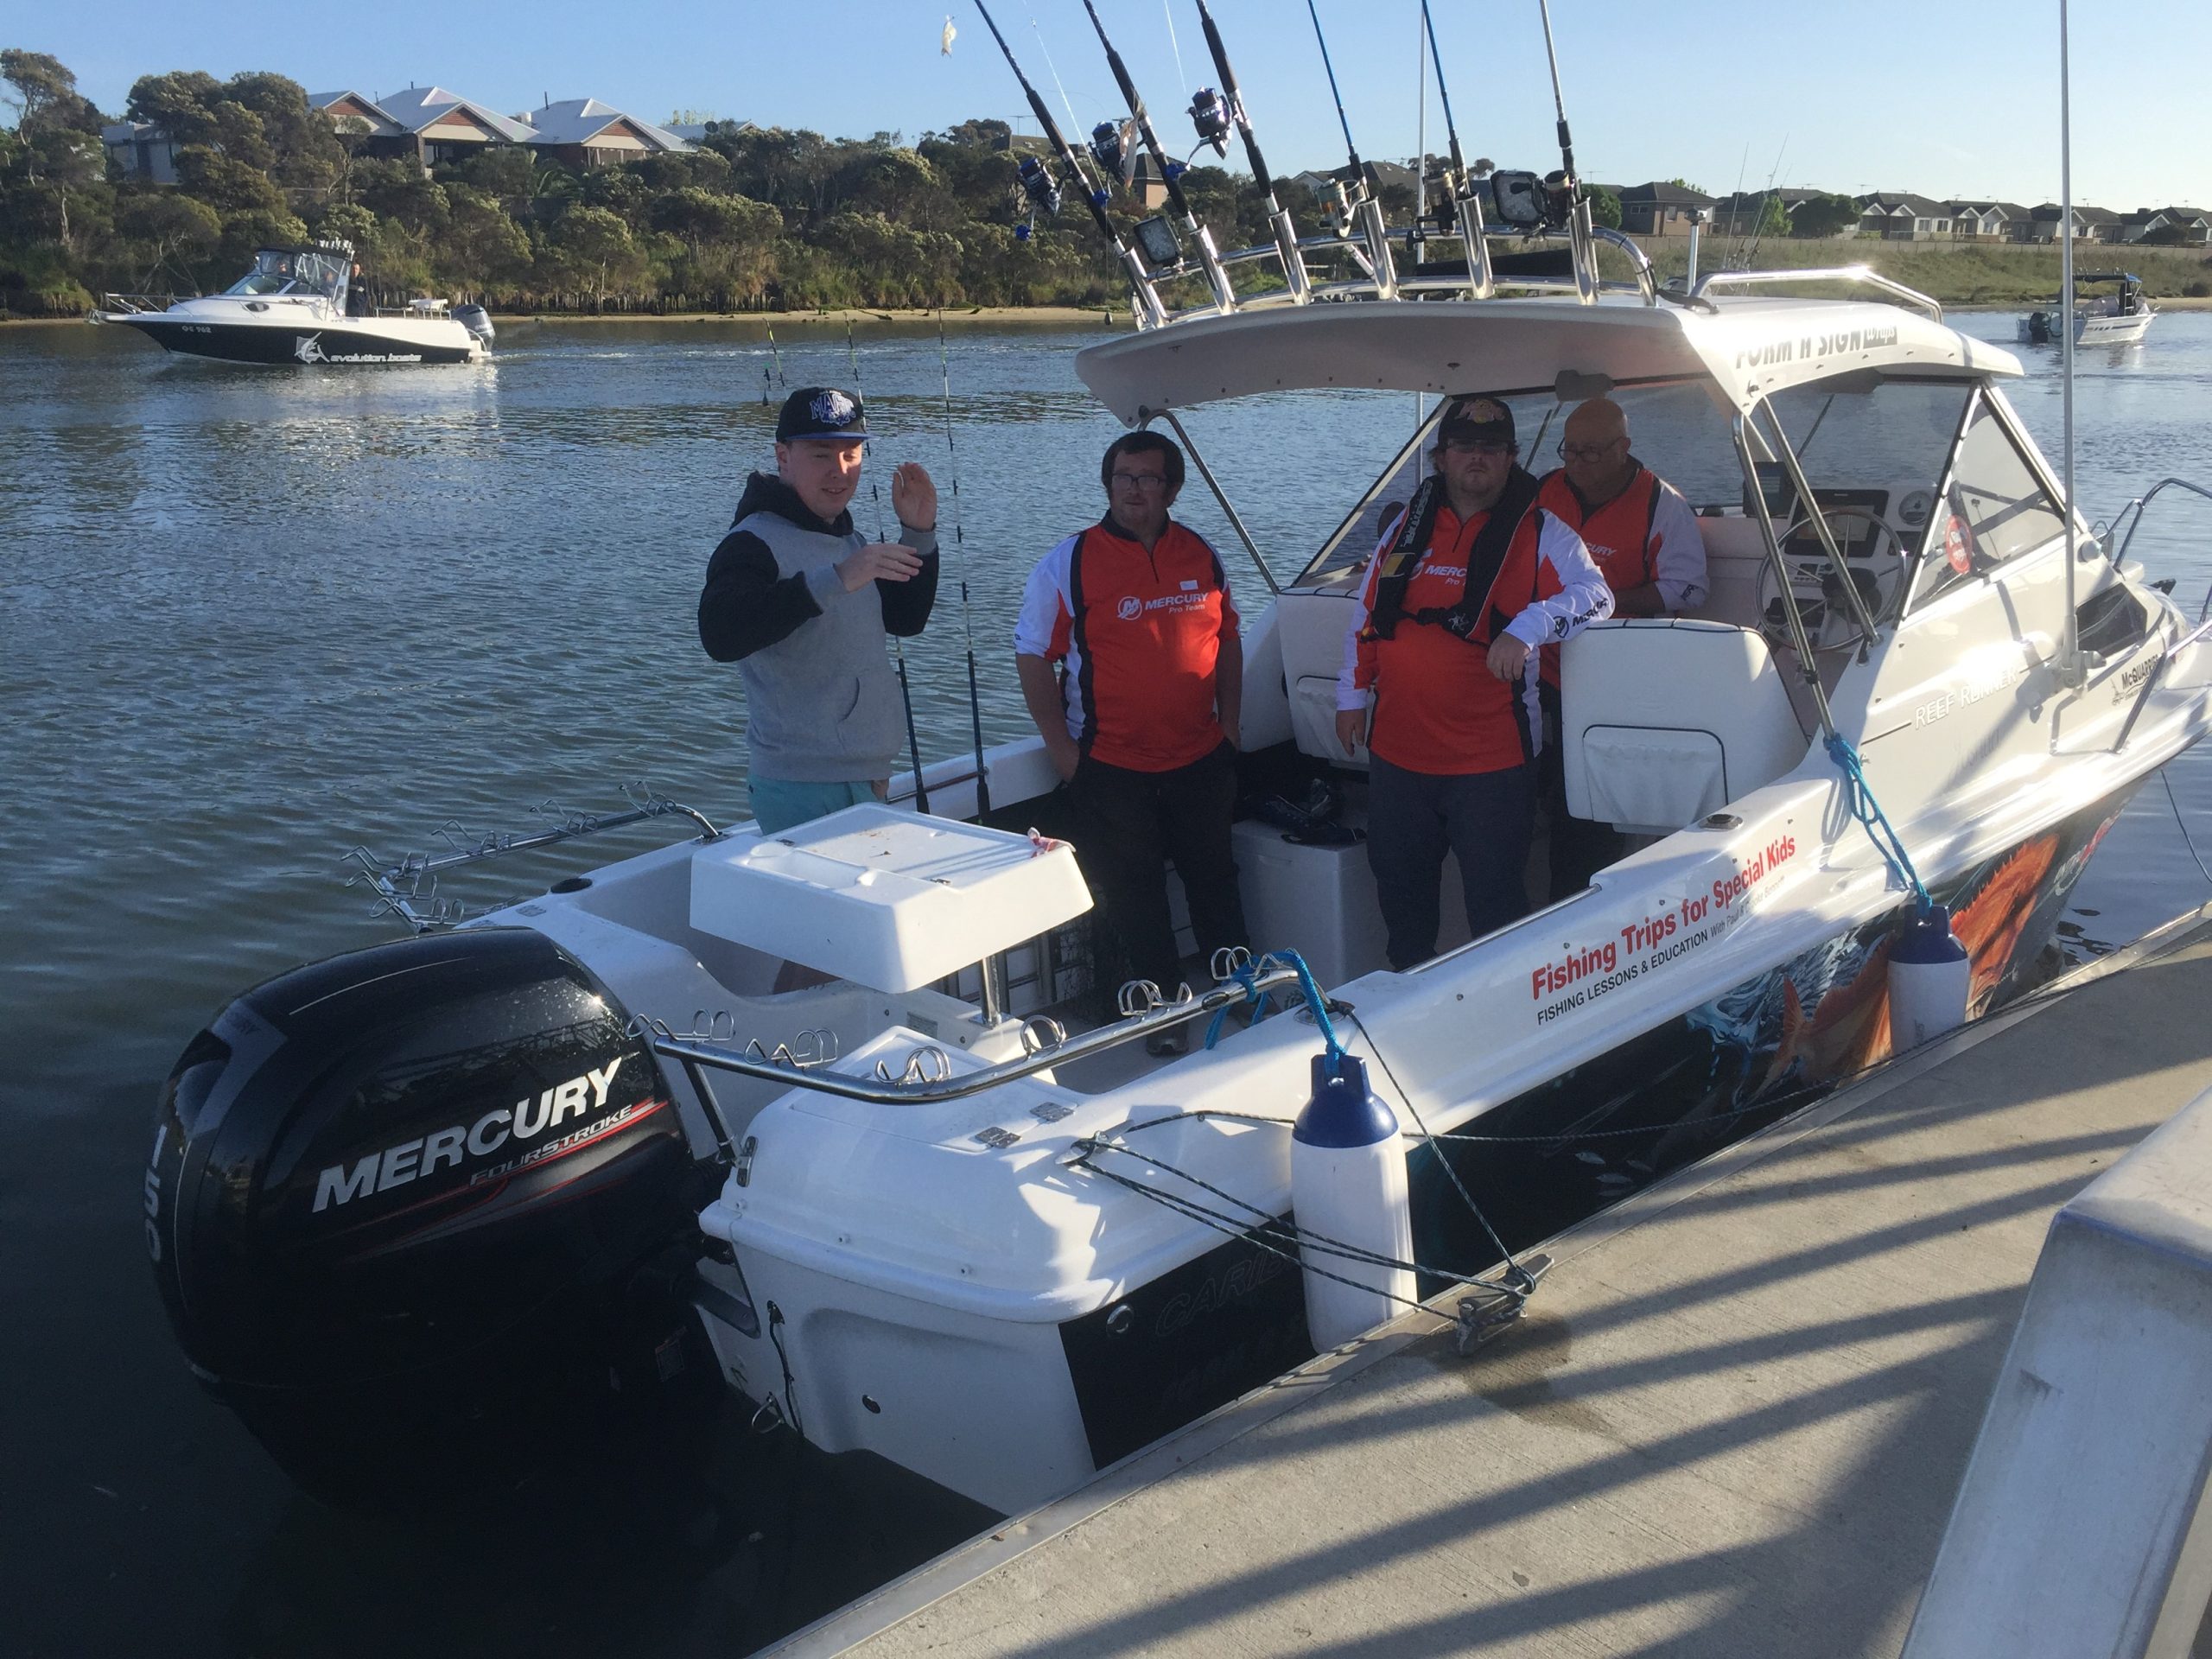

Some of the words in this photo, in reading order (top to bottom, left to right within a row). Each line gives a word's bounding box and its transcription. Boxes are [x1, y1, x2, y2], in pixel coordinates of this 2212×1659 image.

[1425, 564, 1467, 577] MERC
[1585, 542, 1618, 556] CURY
[1145, 593, 1209, 610] MERCURY
[1445, 577, 1459, 586] Pro
[1573, 598, 1608, 626] MERCUR
[1915, 690, 1955, 729] REEF
[1960, 667, 2018, 709] RUNNER
[1532, 941, 1616, 1000] Fishing
[1622, 913, 1676, 955] Trips
[1681, 894, 1708, 926] for
[1713, 852, 1764, 910] Special
[1766, 835, 1796, 871] Kids
[1538, 992, 1585, 1026] FISHING
[1587, 965, 1638, 1001] LESSONS
[1641, 960, 1648, 974] &
[1651, 930, 1707, 969] EDUCATION
[1710, 920, 1726, 938] With
[1726, 909, 1739, 927] Paul
[312, 1056, 622, 1213] MERCURY
[470, 1104, 632, 1187] FOURSTROKE
[1154, 1243, 1292, 1336] CARIB
